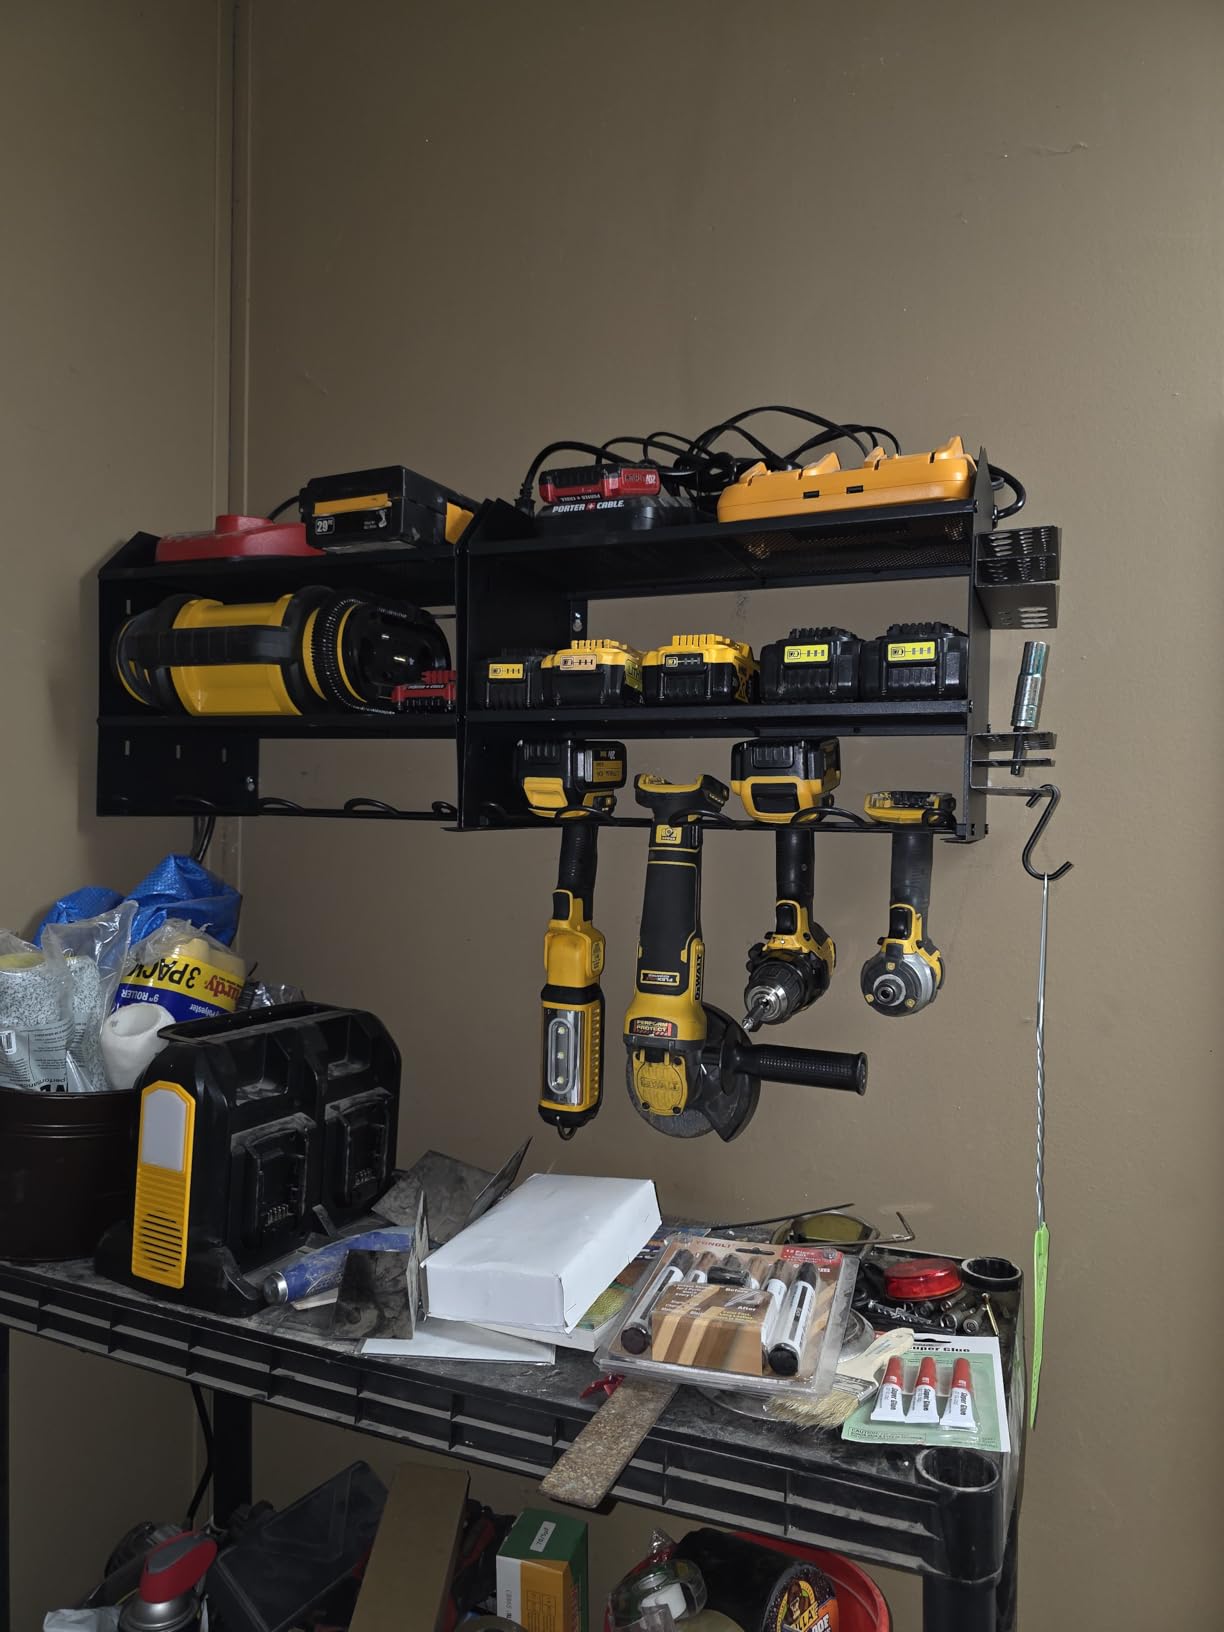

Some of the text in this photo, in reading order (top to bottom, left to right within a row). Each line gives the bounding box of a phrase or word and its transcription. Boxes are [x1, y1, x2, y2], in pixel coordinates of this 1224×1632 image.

[552, 500, 625, 513] PORTER CABLE
[121, 988, 149, 1001] ROLLER
